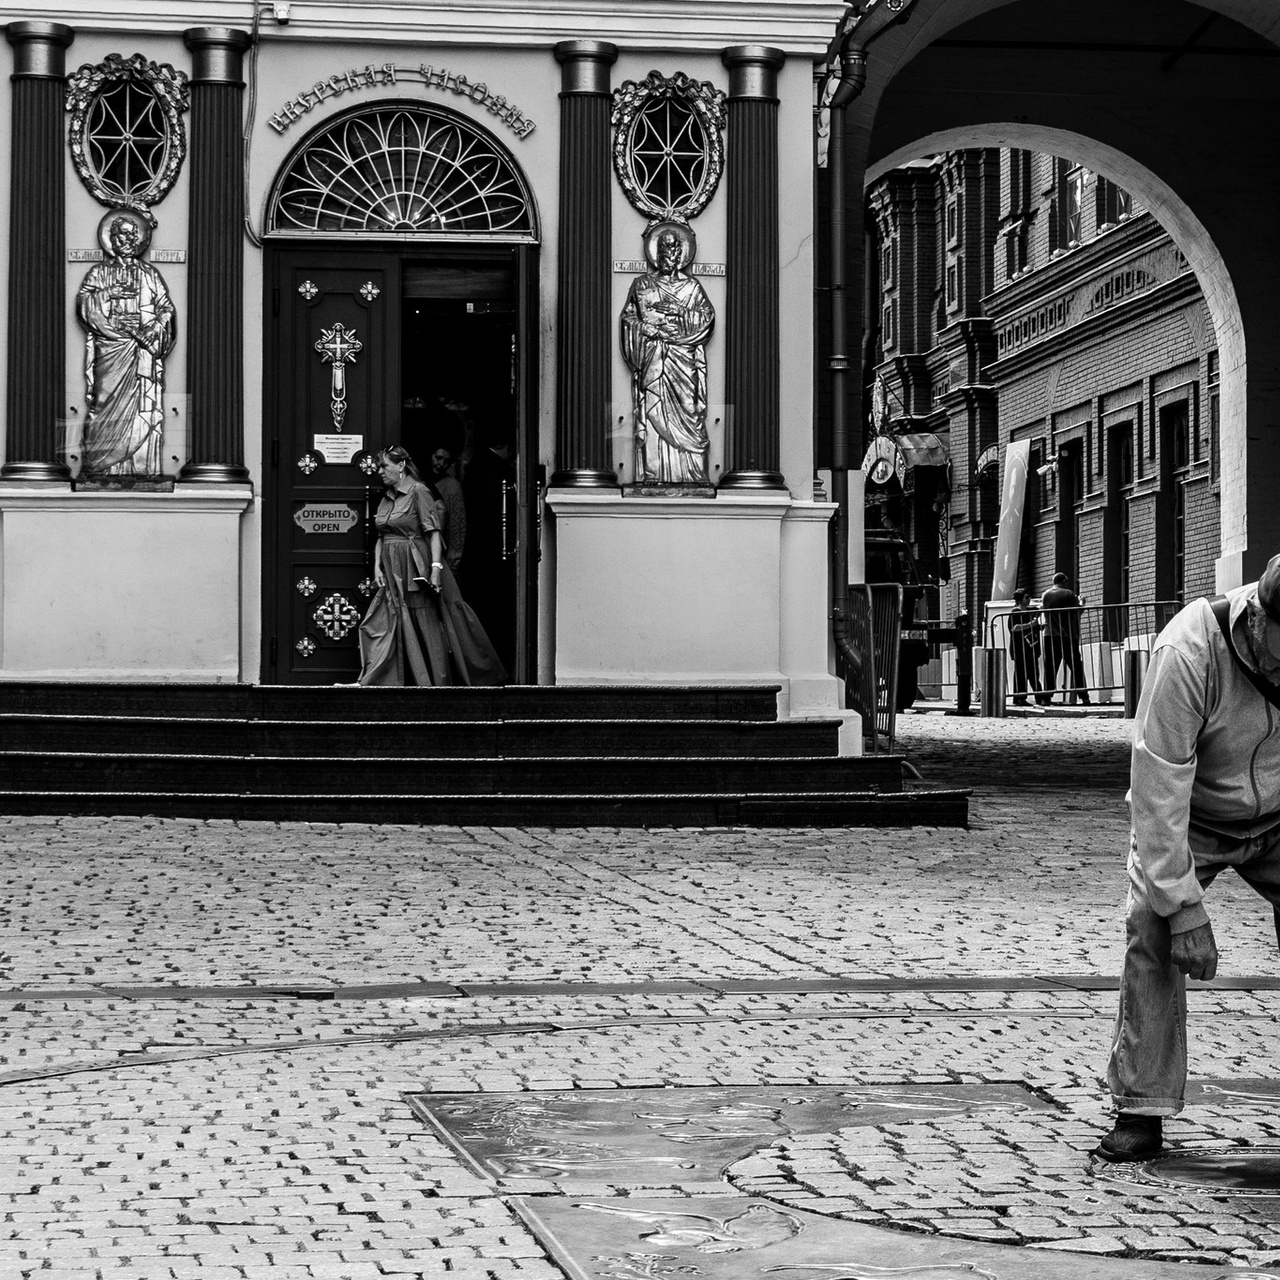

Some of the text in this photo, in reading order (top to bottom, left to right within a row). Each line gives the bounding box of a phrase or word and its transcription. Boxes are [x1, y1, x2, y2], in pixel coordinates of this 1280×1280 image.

[268, 63, 537, 141] ИВЕРСКАЯ ЧАСОВНЯ
[302, 509, 351, 519] ОТКРЫТО
[312, 523, 340, 532] OPEN
